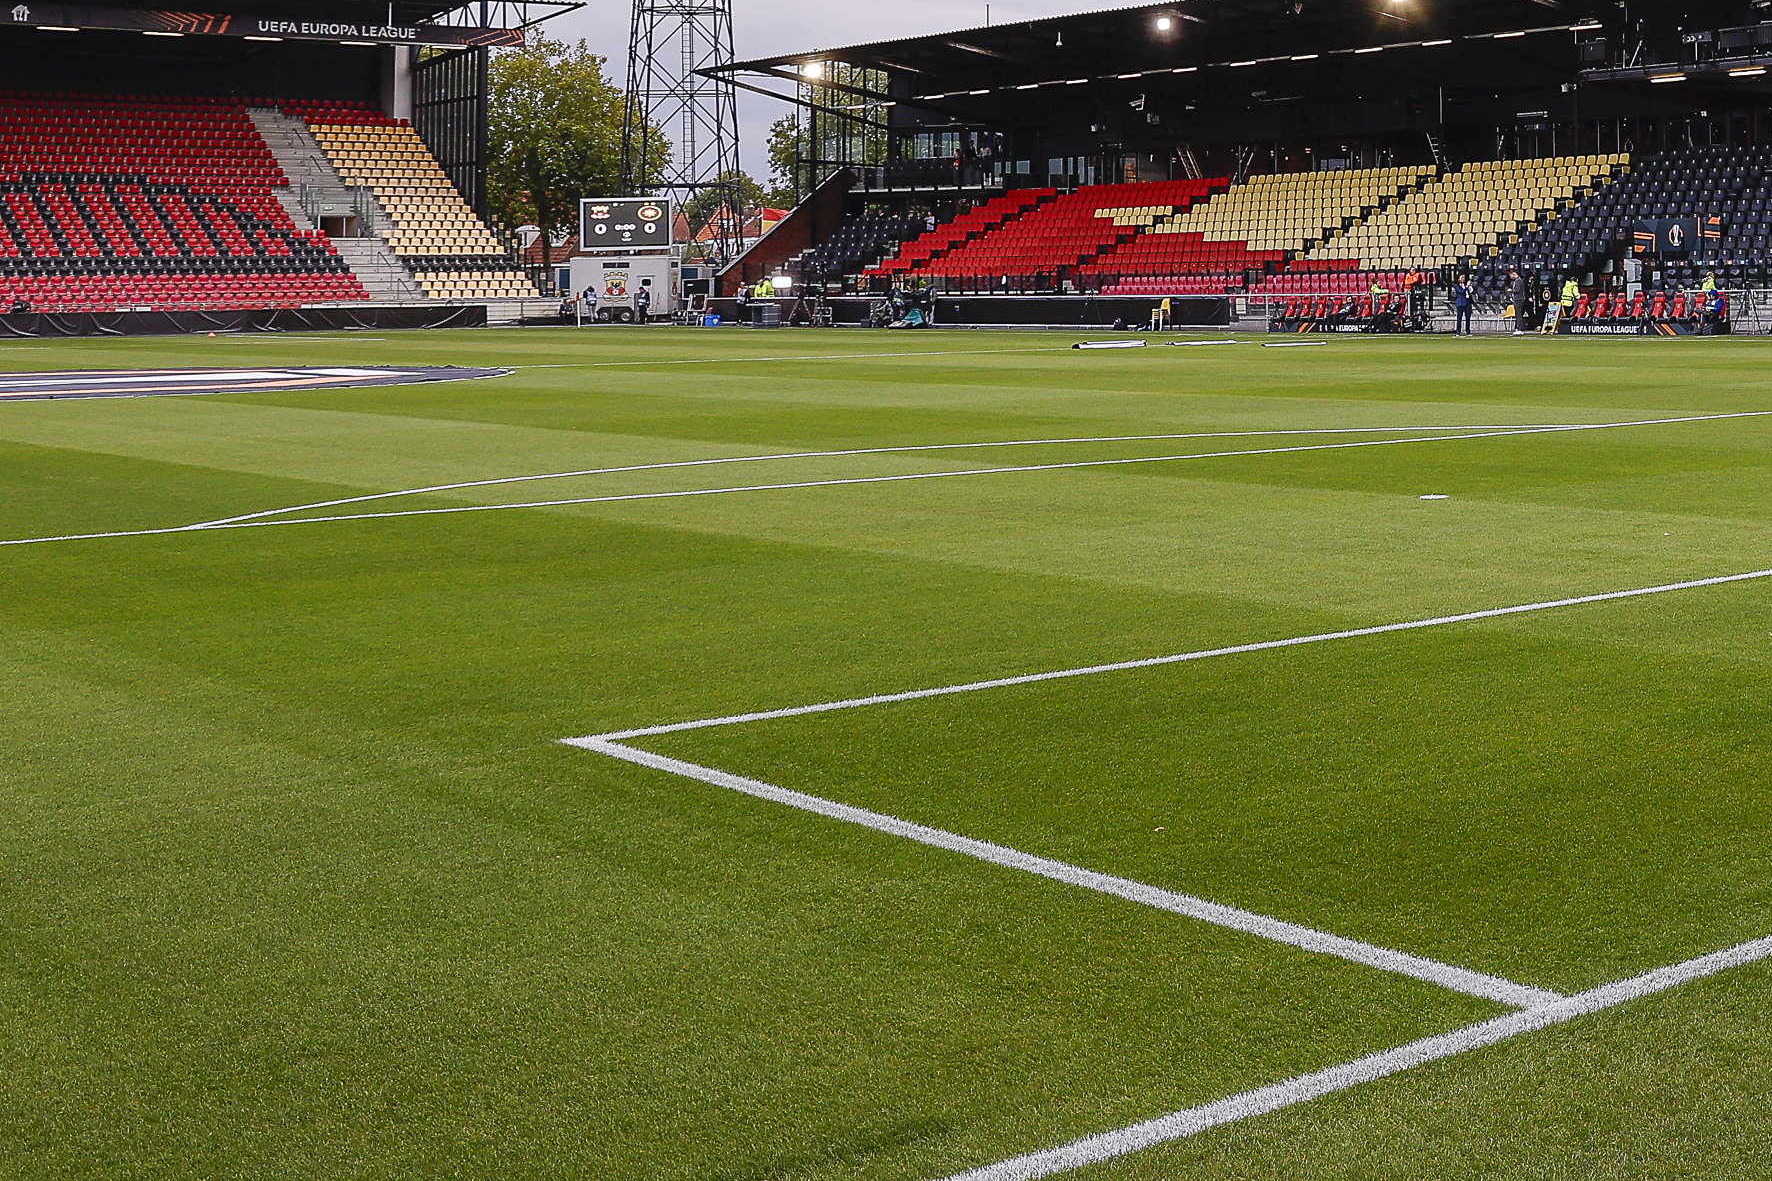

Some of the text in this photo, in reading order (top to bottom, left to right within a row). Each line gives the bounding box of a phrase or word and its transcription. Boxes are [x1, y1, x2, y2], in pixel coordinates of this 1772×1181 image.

[258, 20, 416, 39] UEFA EUROPA LEAGUE
[594, 222, 656, 235] 0 0:00 0
[1570, 325, 1588, 333] UEFA
[1613, 325, 1637, 334] LEAGUE
